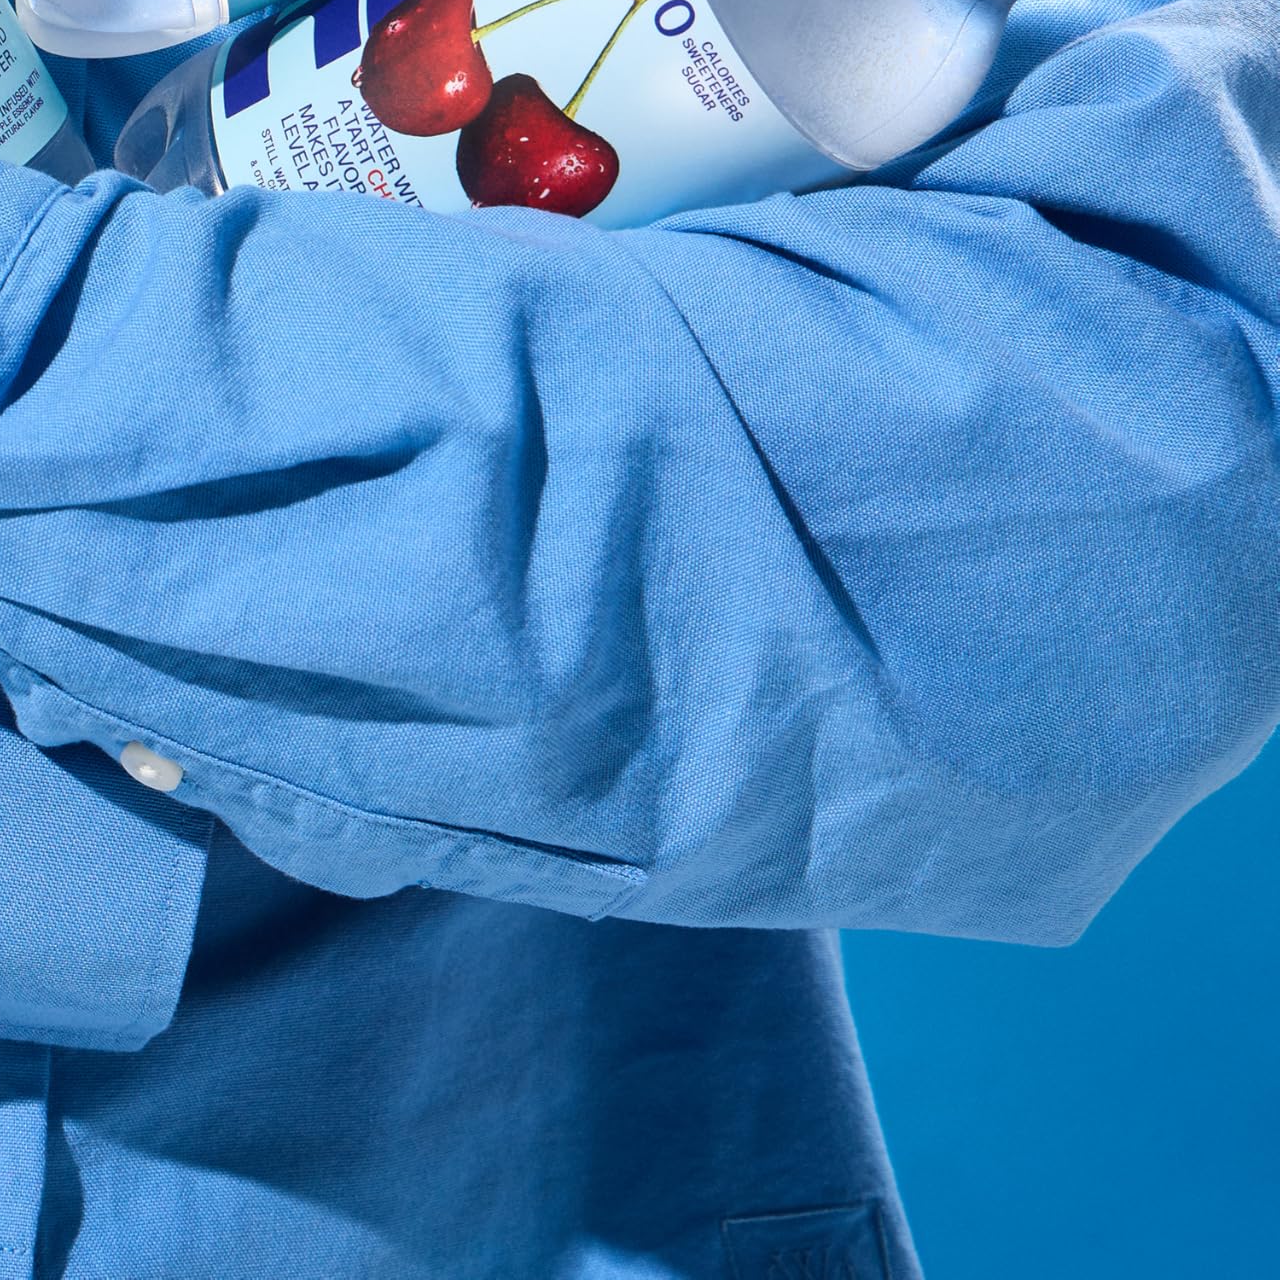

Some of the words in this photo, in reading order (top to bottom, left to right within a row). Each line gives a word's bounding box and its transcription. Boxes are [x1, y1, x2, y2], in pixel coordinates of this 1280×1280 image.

[26, 67, 40, 88] WITH
[682, 38, 743, 122] SWEETENERS
[682, 66, 717, 111] SUGAR
[702, 41, 750, 106] CALORIES
[12, 92, 35, 119] ESSENCE
[23, 97, 44, 121] FLAVORS
[337, 99, 353, 115] A
[261, 128, 278, 166] STILL
[274, 167, 290, 191] WAT
[281, 113, 310, 178] LEVEL
[299, 103, 334, 176] MAKES
[344, 113, 376, 165] TART
[361, 104, 400, 174] WATER
